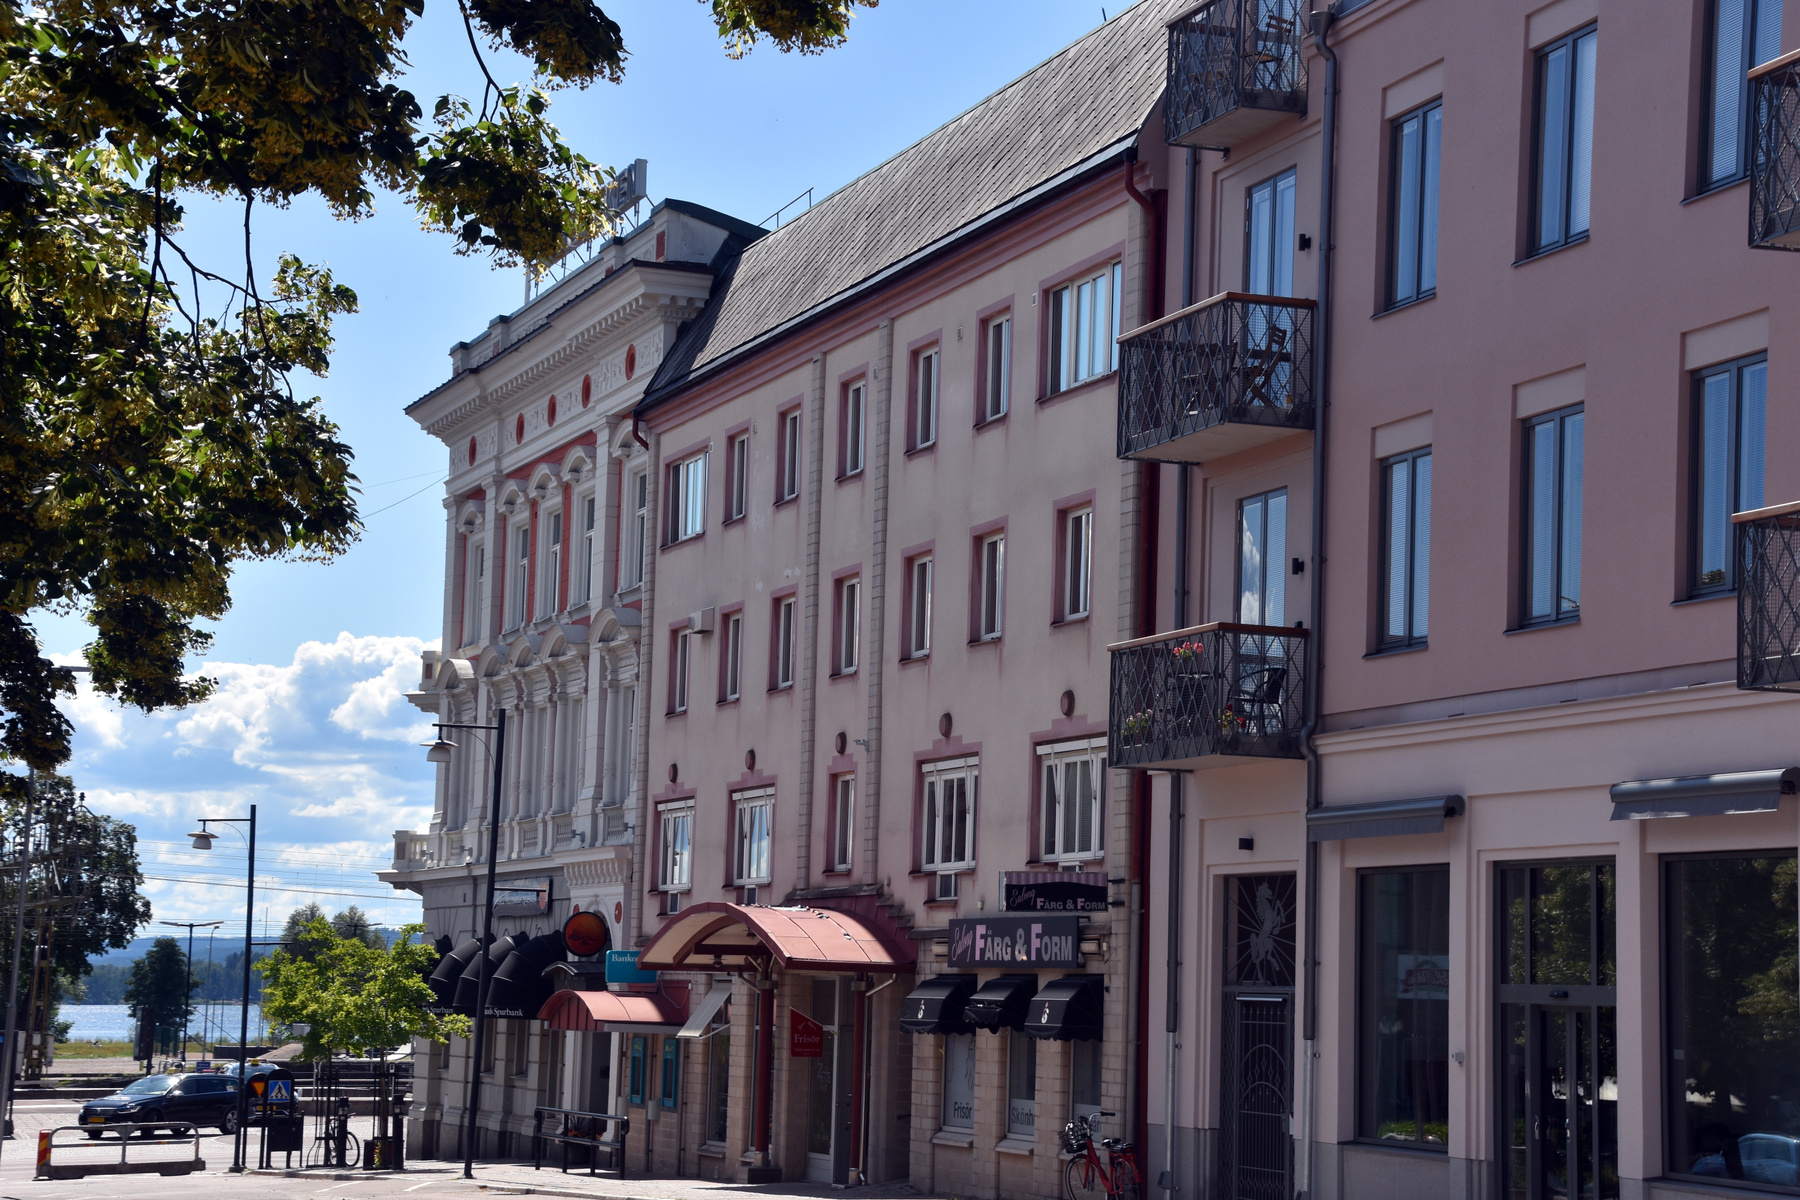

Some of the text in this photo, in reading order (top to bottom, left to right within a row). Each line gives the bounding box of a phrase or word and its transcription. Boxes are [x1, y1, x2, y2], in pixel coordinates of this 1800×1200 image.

[1009, 886, 1106, 910] Salong FÄRG & FORM
[951, 923, 1073, 962] Salong FÄRG & FORM
[611, 953, 637, 962] Banko
[429, 1005, 454, 1014] Sparban
[493, 1007, 524, 1018] Sparbank
[793, 1033, 821, 1043] Frisör
[953, 1101, 973, 1119] Frisör
[1011, 1106, 1035, 1127] Skönh
